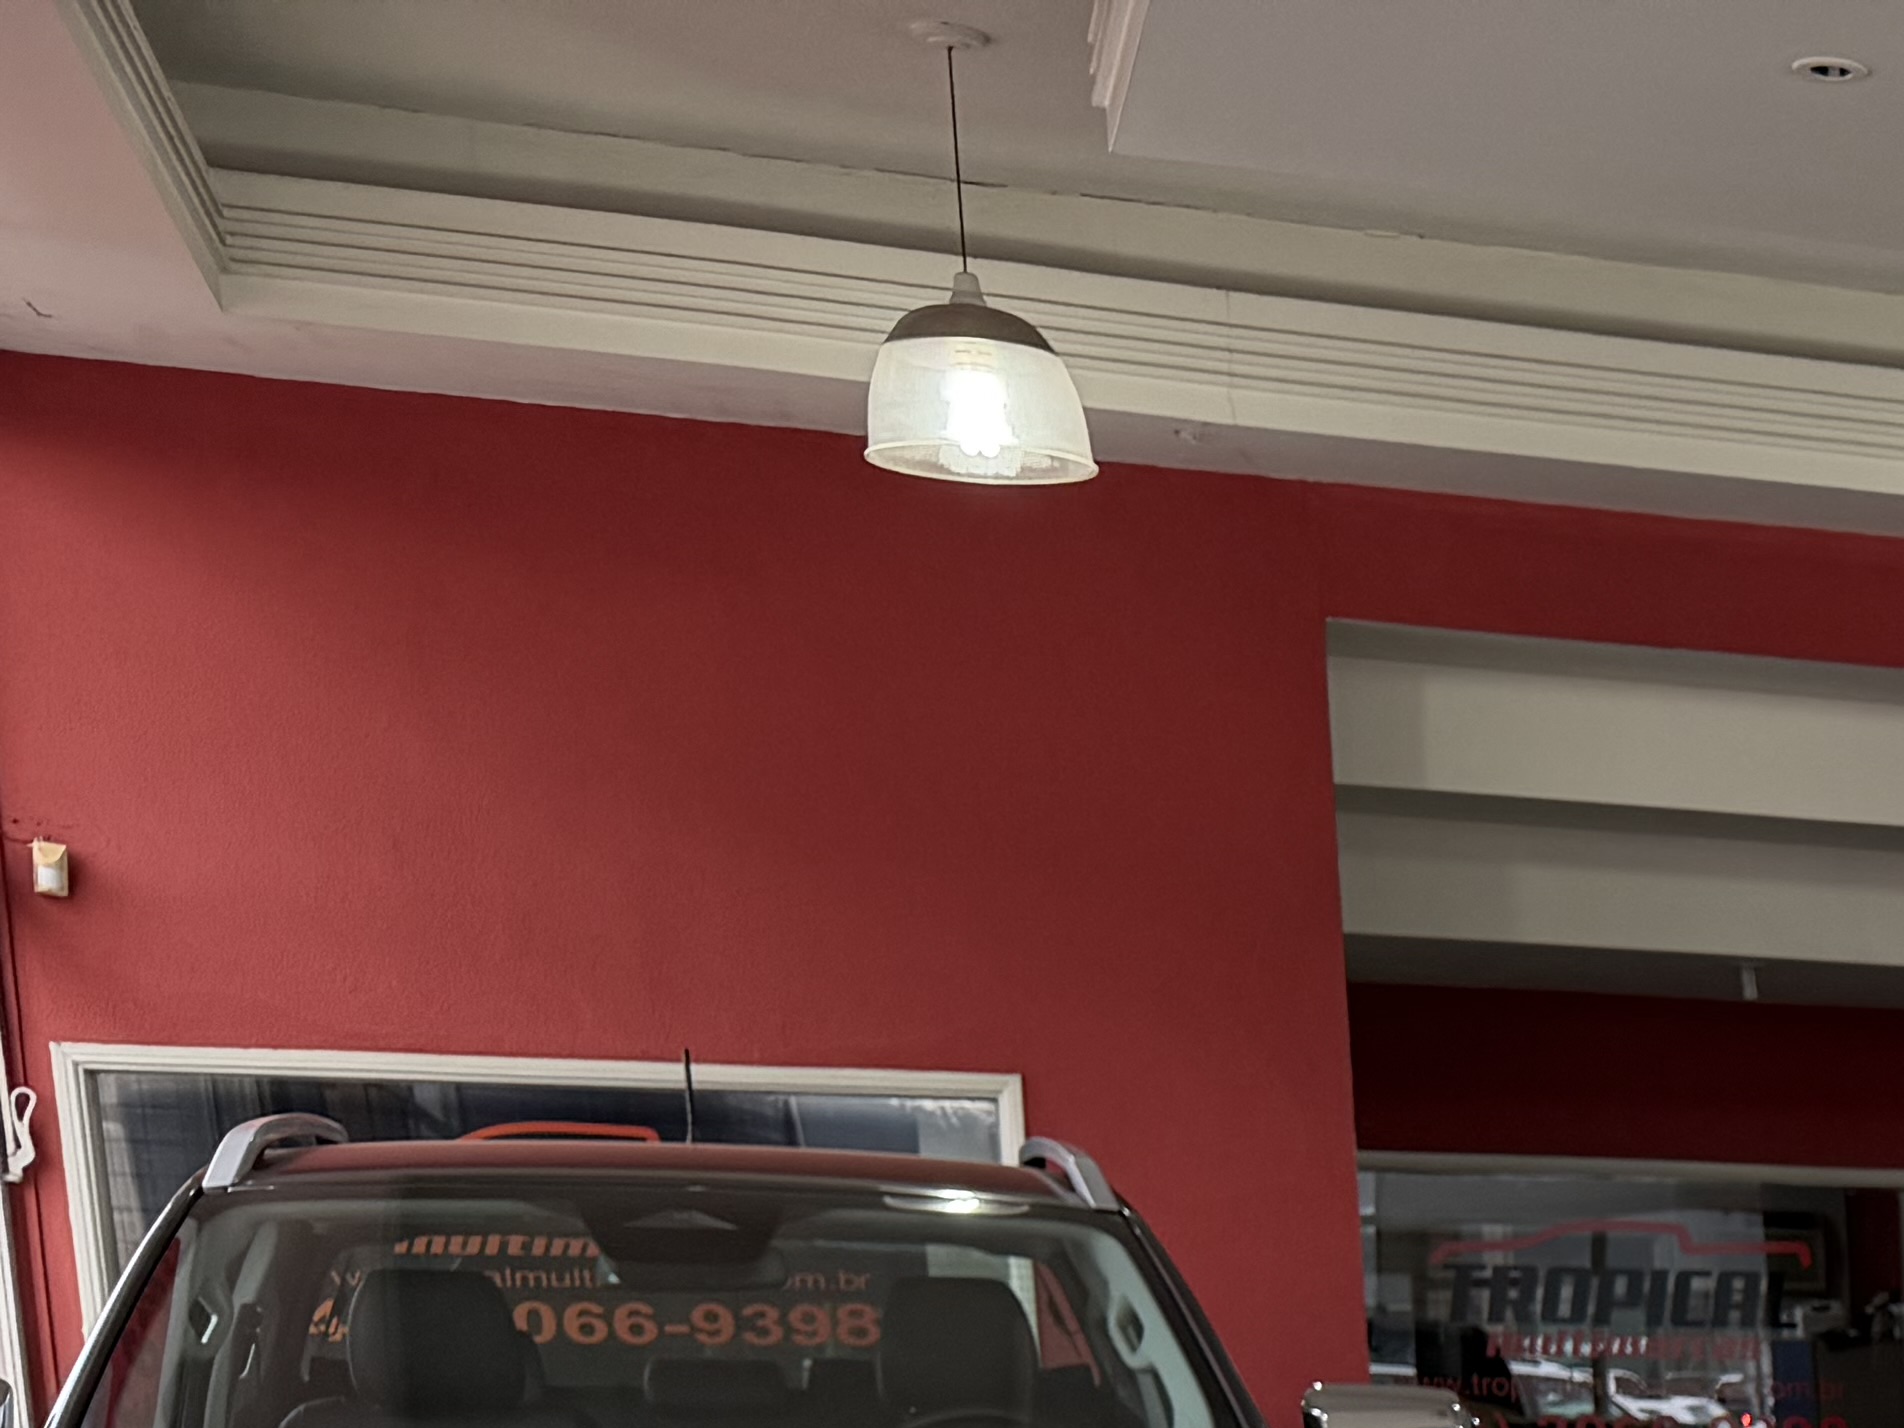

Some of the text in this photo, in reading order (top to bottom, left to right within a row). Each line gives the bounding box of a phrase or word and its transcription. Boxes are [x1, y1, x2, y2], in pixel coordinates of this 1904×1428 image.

[393, 1233, 600, 1256] multim
[1444, 1264, 1797, 1329] TROPICAL
[513, 1301, 881, 1346] 066-9398
